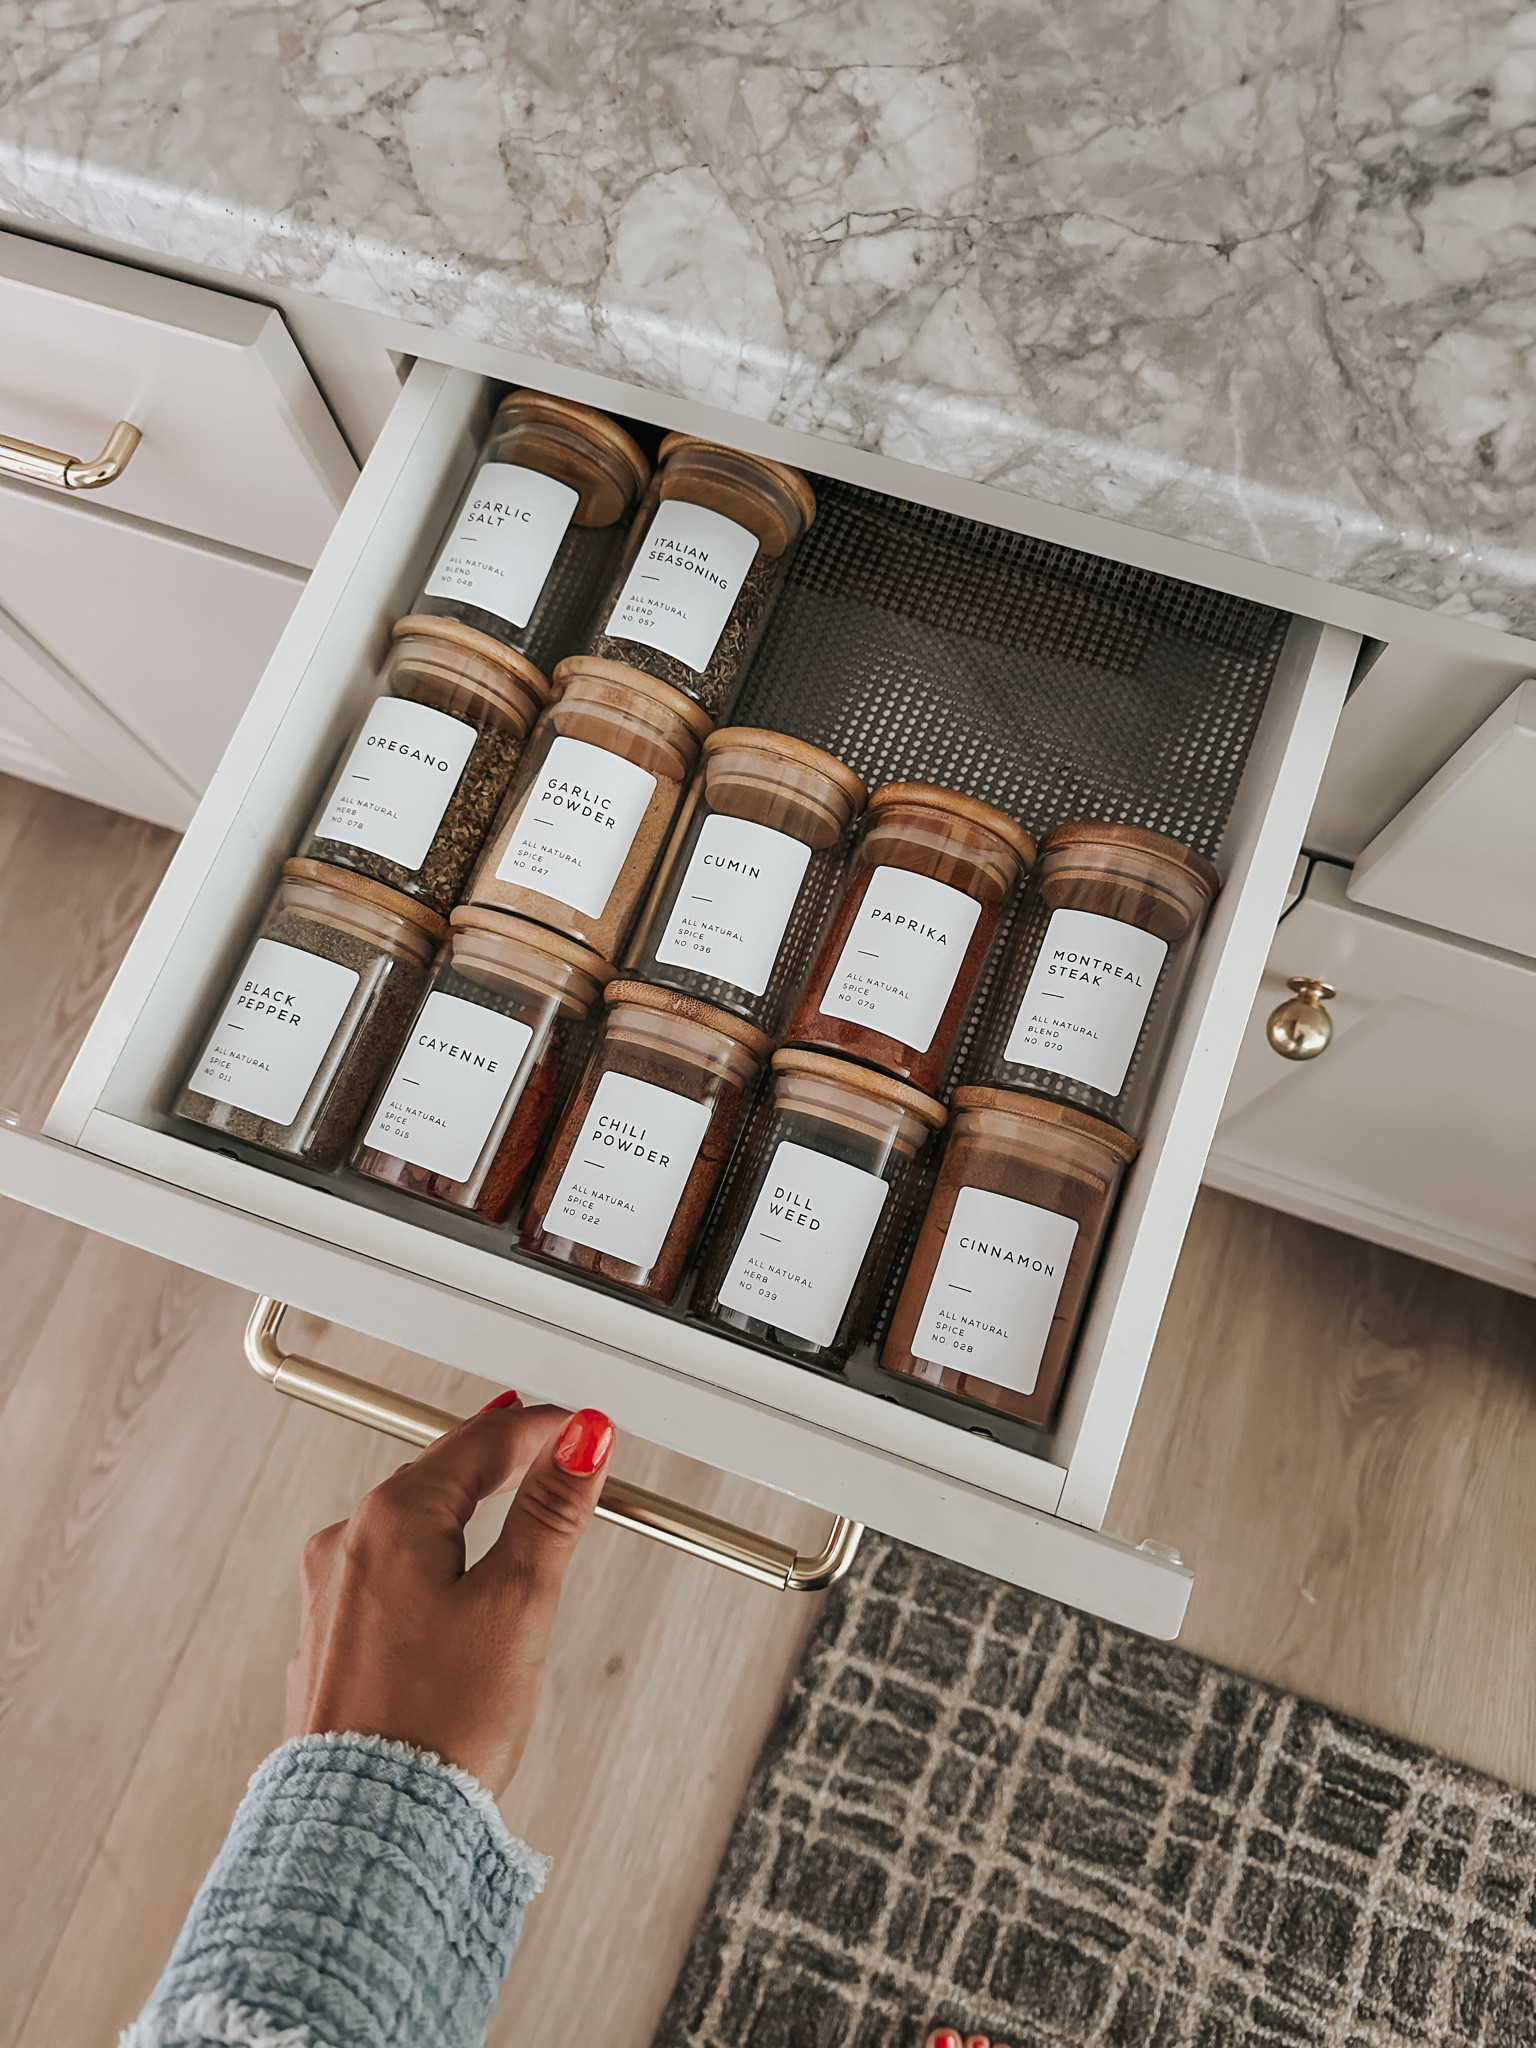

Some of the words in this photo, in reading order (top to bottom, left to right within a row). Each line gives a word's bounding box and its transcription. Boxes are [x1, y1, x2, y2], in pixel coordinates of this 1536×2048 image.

[467, 512, 505, 527] SALT
[473, 500, 531, 523] GARLIC
[654, 538, 709, 562] ITALIAN
[445, 566, 471, 575] BLEND
[465, 559, 504, 577] NATURAL
[648, 550, 728, 590] SEASONING
[625, 604, 653, 616] BLEND
[629, 595, 644, 604] ALL
[647, 599, 687, 620] NATURAL
[638, 617, 655, 627] 057
[367, 736, 448, 772] OREGANO
[548, 778, 611, 810] GARLIC
[336, 806, 357, 816] HERB
[340, 796, 354, 805] ALL
[356, 800, 398, 819] NATURAL
[541, 792, 615, 829] POWDER
[347, 819, 364, 829] 078
[517, 849, 543, 862] SPICE
[522, 840, 537, 849] ALL
[540, 845, 581, 867] NATURAL
[531, 865, 549, 875] 047
[703, 854, 760, 879] CUMIN
[677, 928, 704, 940] SPICE
[681, 918, 697, 927] ALL
[701, 922, 743, 942] NATURAL
[871, 909, 946, 946] PAPRIKA
[693, 943, 711, 954] 036
[1048, 964, 1102, 987] STEAK
[1053, 950, 1142, 988] MONTREAL
[244, 981, 296, 1007] BLACK
[842, 983, 870, 996] SPICE
[846, 972, 863, 983] ALL
[866, 978, 909, 999] NATURAL
[237, 995, 301, 1026] PEPPER
[857, 999, 875, 1010] 079
[1027, 1025, 1060, 1038] BLEND
[1030, 1015, 1048, 1024] ALL
[1052, 1019, 1098, 1039] NATURAL
[418, 1035, 498, 1073] CAYENNE
[1044, 1040, 1063, 1051] 070
[209, 1057, 231, 1069] SPICE
[214, 1046, 226, 1055] ALL
[229, 1051, 270, 1071] NATURAL
[219, 1072, 232, 1082] 011
[385, 1111, 407, 1125] SPICE
[389, 1101, 403, 1111] ALL
[405, 1107, 446, 1128] NATURAL
[395, 1128, 410, 1139] 015
[598, 1116, 646, 1141] CHILI
[592, 1130, 670, 1168] POWDER
[567, 1195, 594, 1210] SPICE
[571, 1184, 588, 1195] ALL
[590, 1190, 635, 1212] NATURAL
[774, 1187, 812, 1211] DILL
[581, 1213, 600, 1225] 022
[770, 1202, 820, 1231] WEED
[959, 1237, 1054, 1277] CINNAMON
[743, 1268, 768, 1284] HERB
[748, 1257, 764, 1269] ALL
[768, 1265, 812, 1289] NATURAL
[758, 1288, 777, 1301] 039
[935, 1321, 965, 1337] SPICE
[938, 1310, 957, 1321] ALL
[960, 1316, 1008, 1338] NATURAL
[953, 1340, 973, 1353] 028
